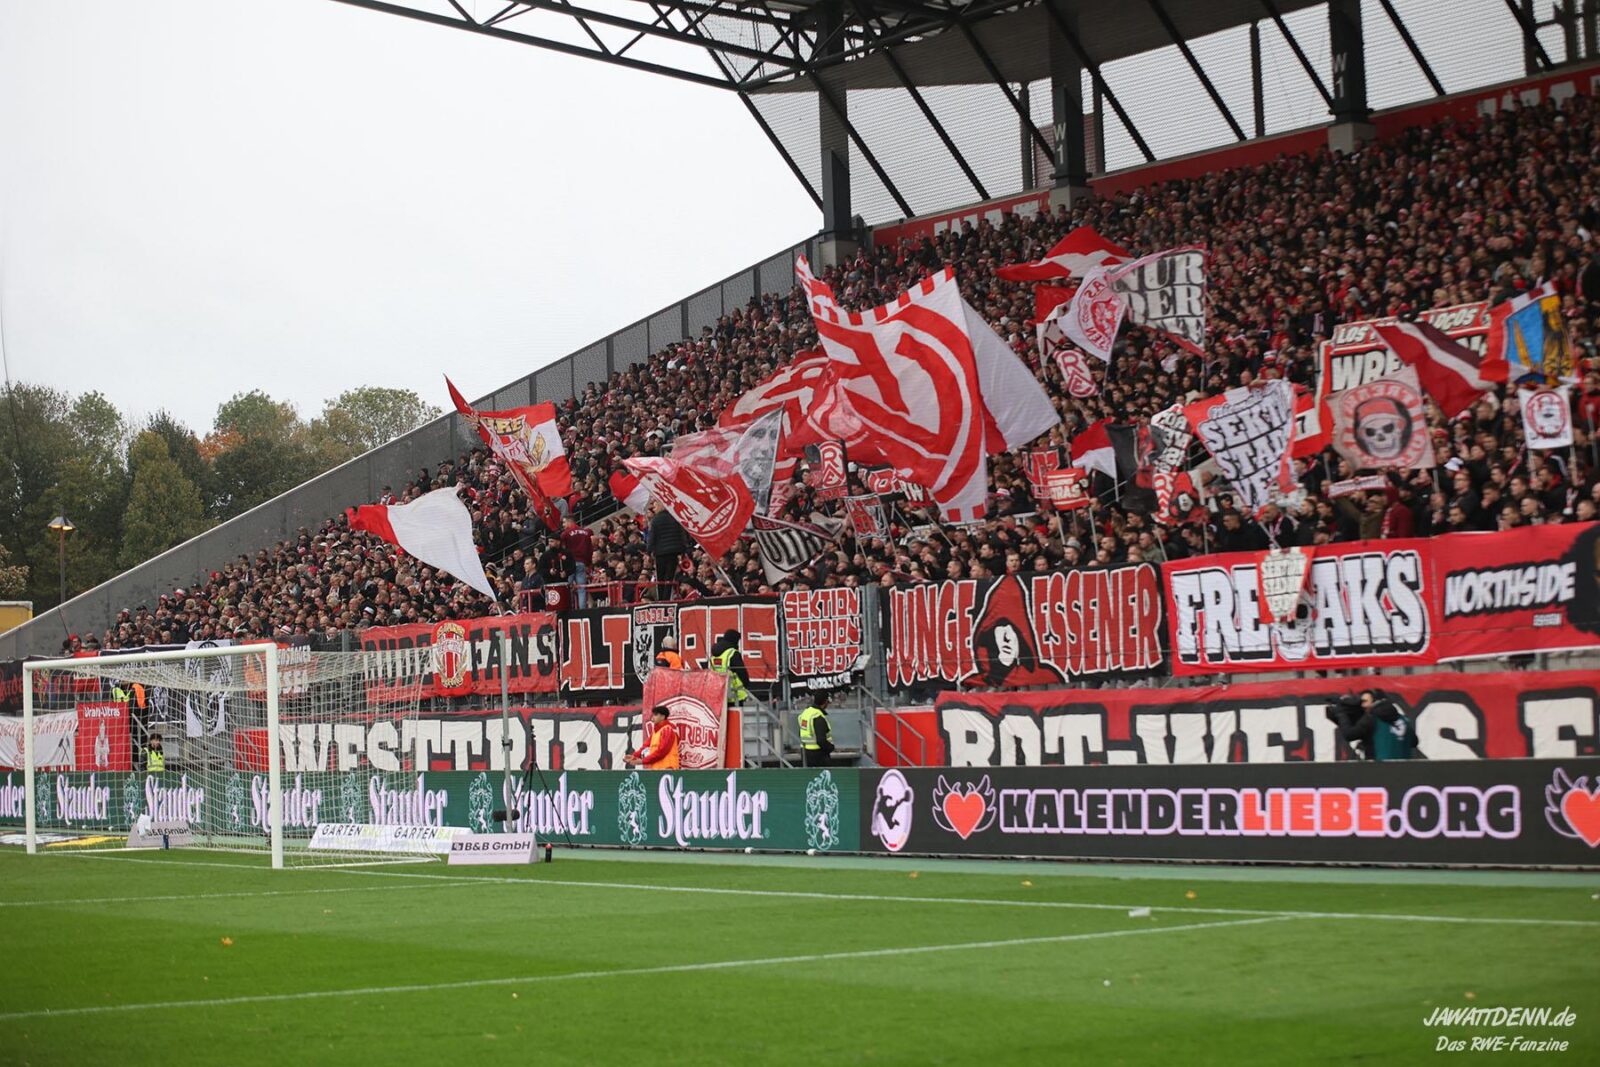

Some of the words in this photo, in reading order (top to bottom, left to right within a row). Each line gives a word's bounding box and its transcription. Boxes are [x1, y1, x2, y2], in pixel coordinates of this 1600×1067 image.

[1333, 54, 1348, 72] W
[1335, 80, 1345, 98] 1
[1053, 122, 1067, 140] W
[1057, 146, 1065, 164] 1
[1336, 325, 1369, 345] LOS
[783, 587, 860, 620] SEKTION
[1170, 551, 1431, 664] FREAKS
[1445, 562, 1577, 616] NORTHSIDE
[785, 617, 861, 650] STADION
[886, 578, 978, 687] JUNGE
[1031, 562, 1163, 675] ESSENER
[469, 624, 556, 681] FANS
[942, 702, 1479, 767] ROT-WEIS
[56, 772, 110, 826] Stauder
[369, 772, 448, 826] Stauder
[658, 771, 769, 847] Stauder
[1000, 785, 1522, 839] KALENDERLIEBE.ORG
[464, 842, 490, 851] B&B
[492, 841, 531, 851] GmbH
